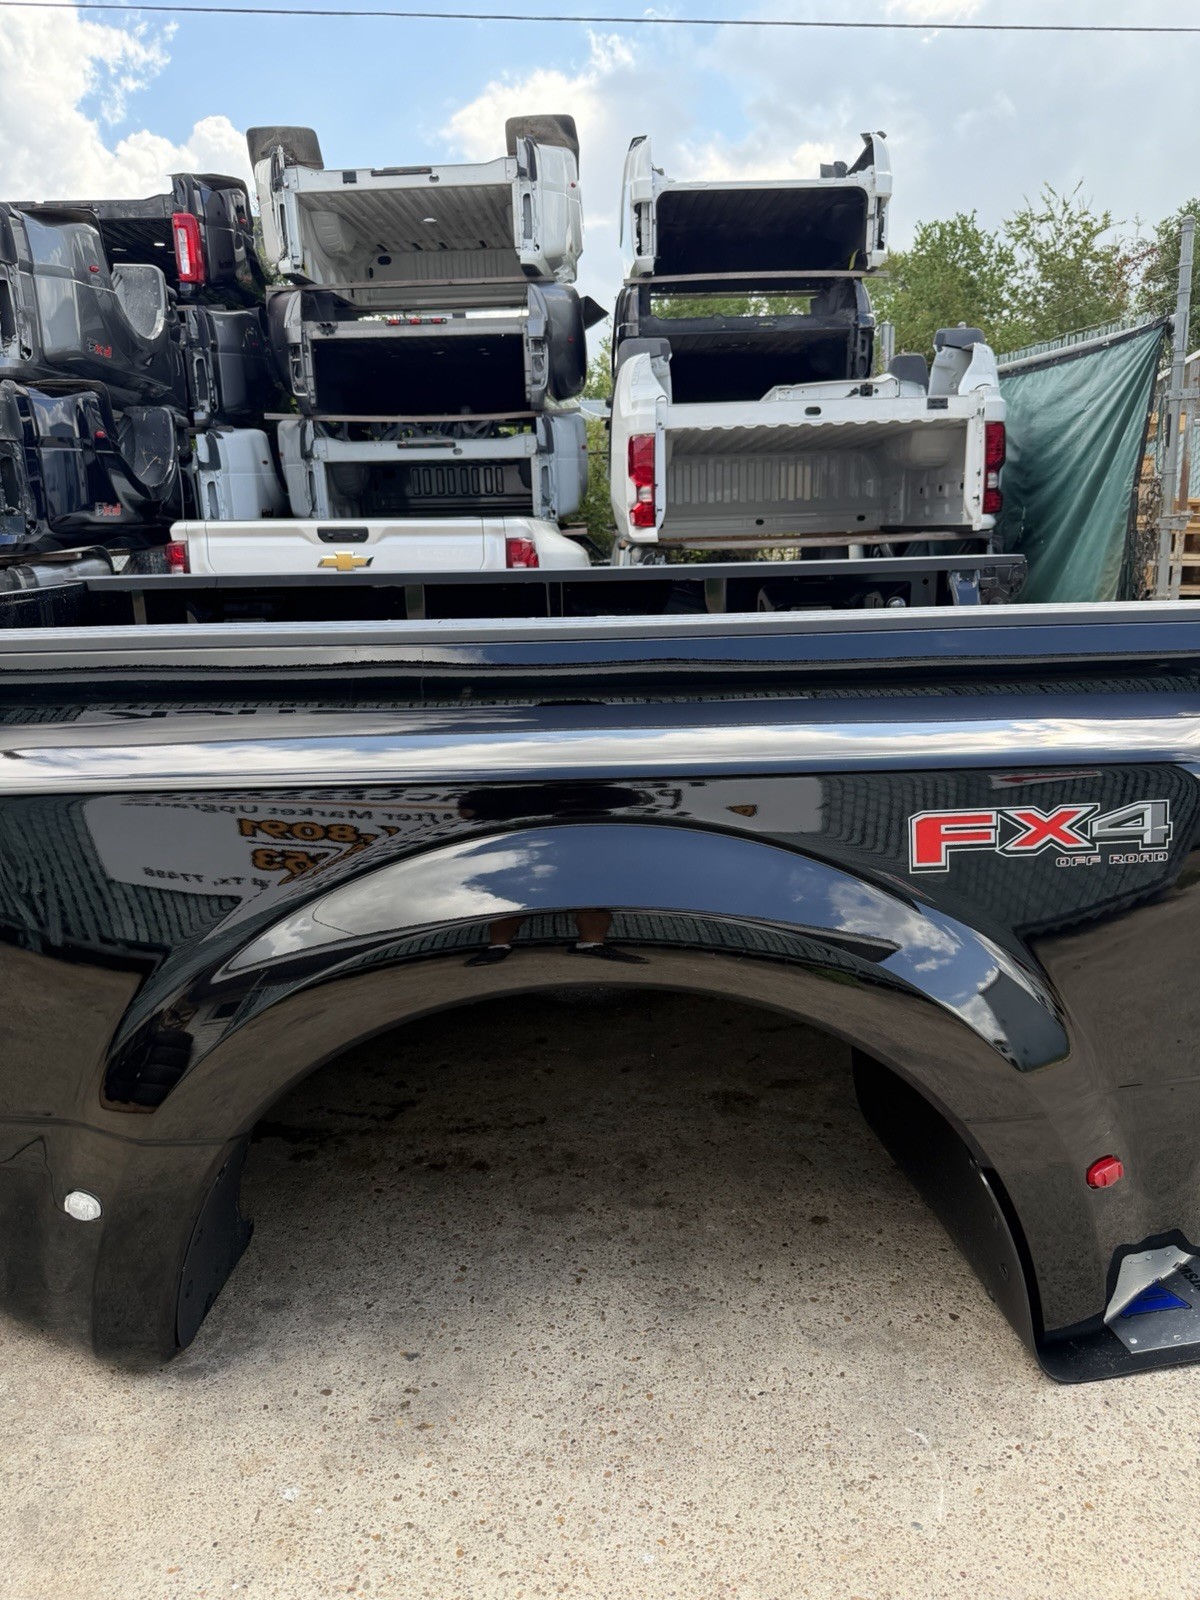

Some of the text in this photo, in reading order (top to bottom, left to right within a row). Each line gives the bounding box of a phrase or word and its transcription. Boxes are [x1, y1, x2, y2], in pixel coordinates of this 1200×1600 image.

[907, 799, 1173, 874] FX4
[1055, 851, 1169, 867] OFF ROAD
